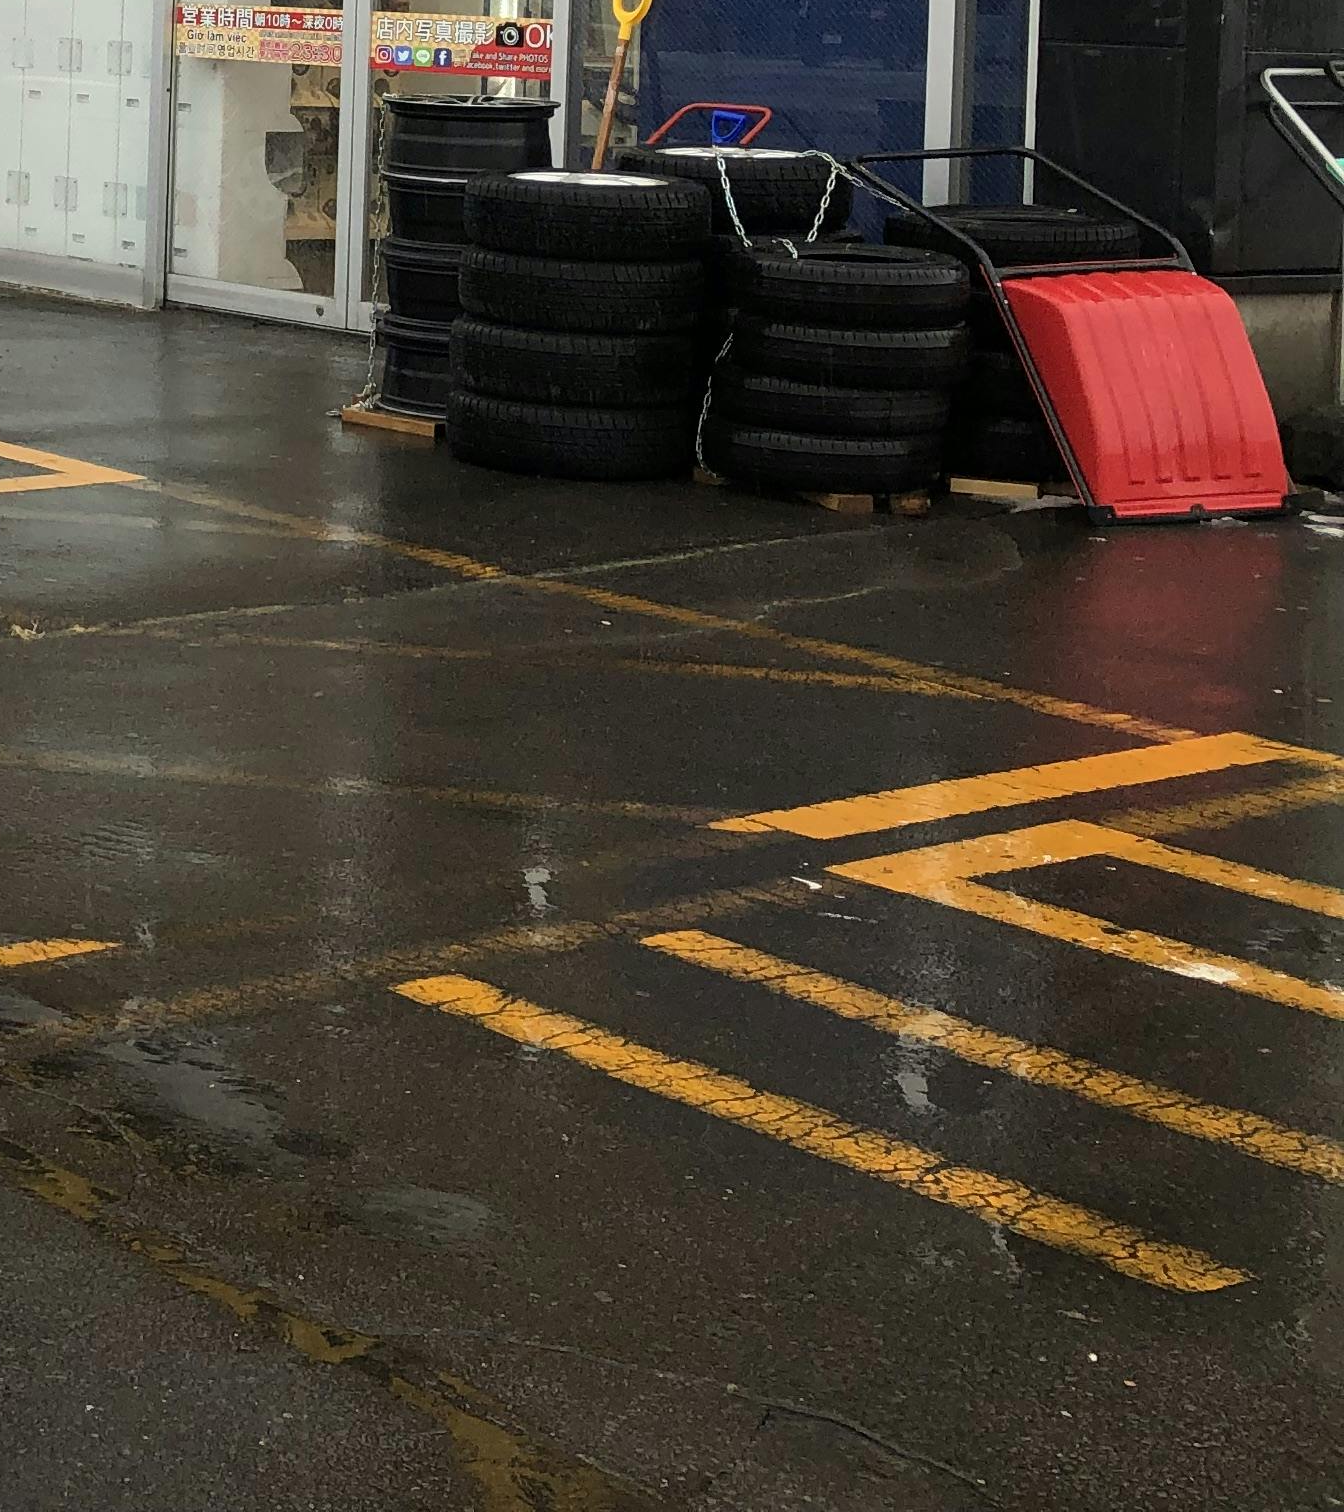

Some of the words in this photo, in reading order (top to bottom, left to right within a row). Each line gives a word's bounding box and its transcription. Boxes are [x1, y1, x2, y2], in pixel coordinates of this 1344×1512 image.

[181, 5, 254, 30] 営業時間
[376, 16, 495, 46] 店内写真撮影
[518, 54, 549, 63] PHOTOS
